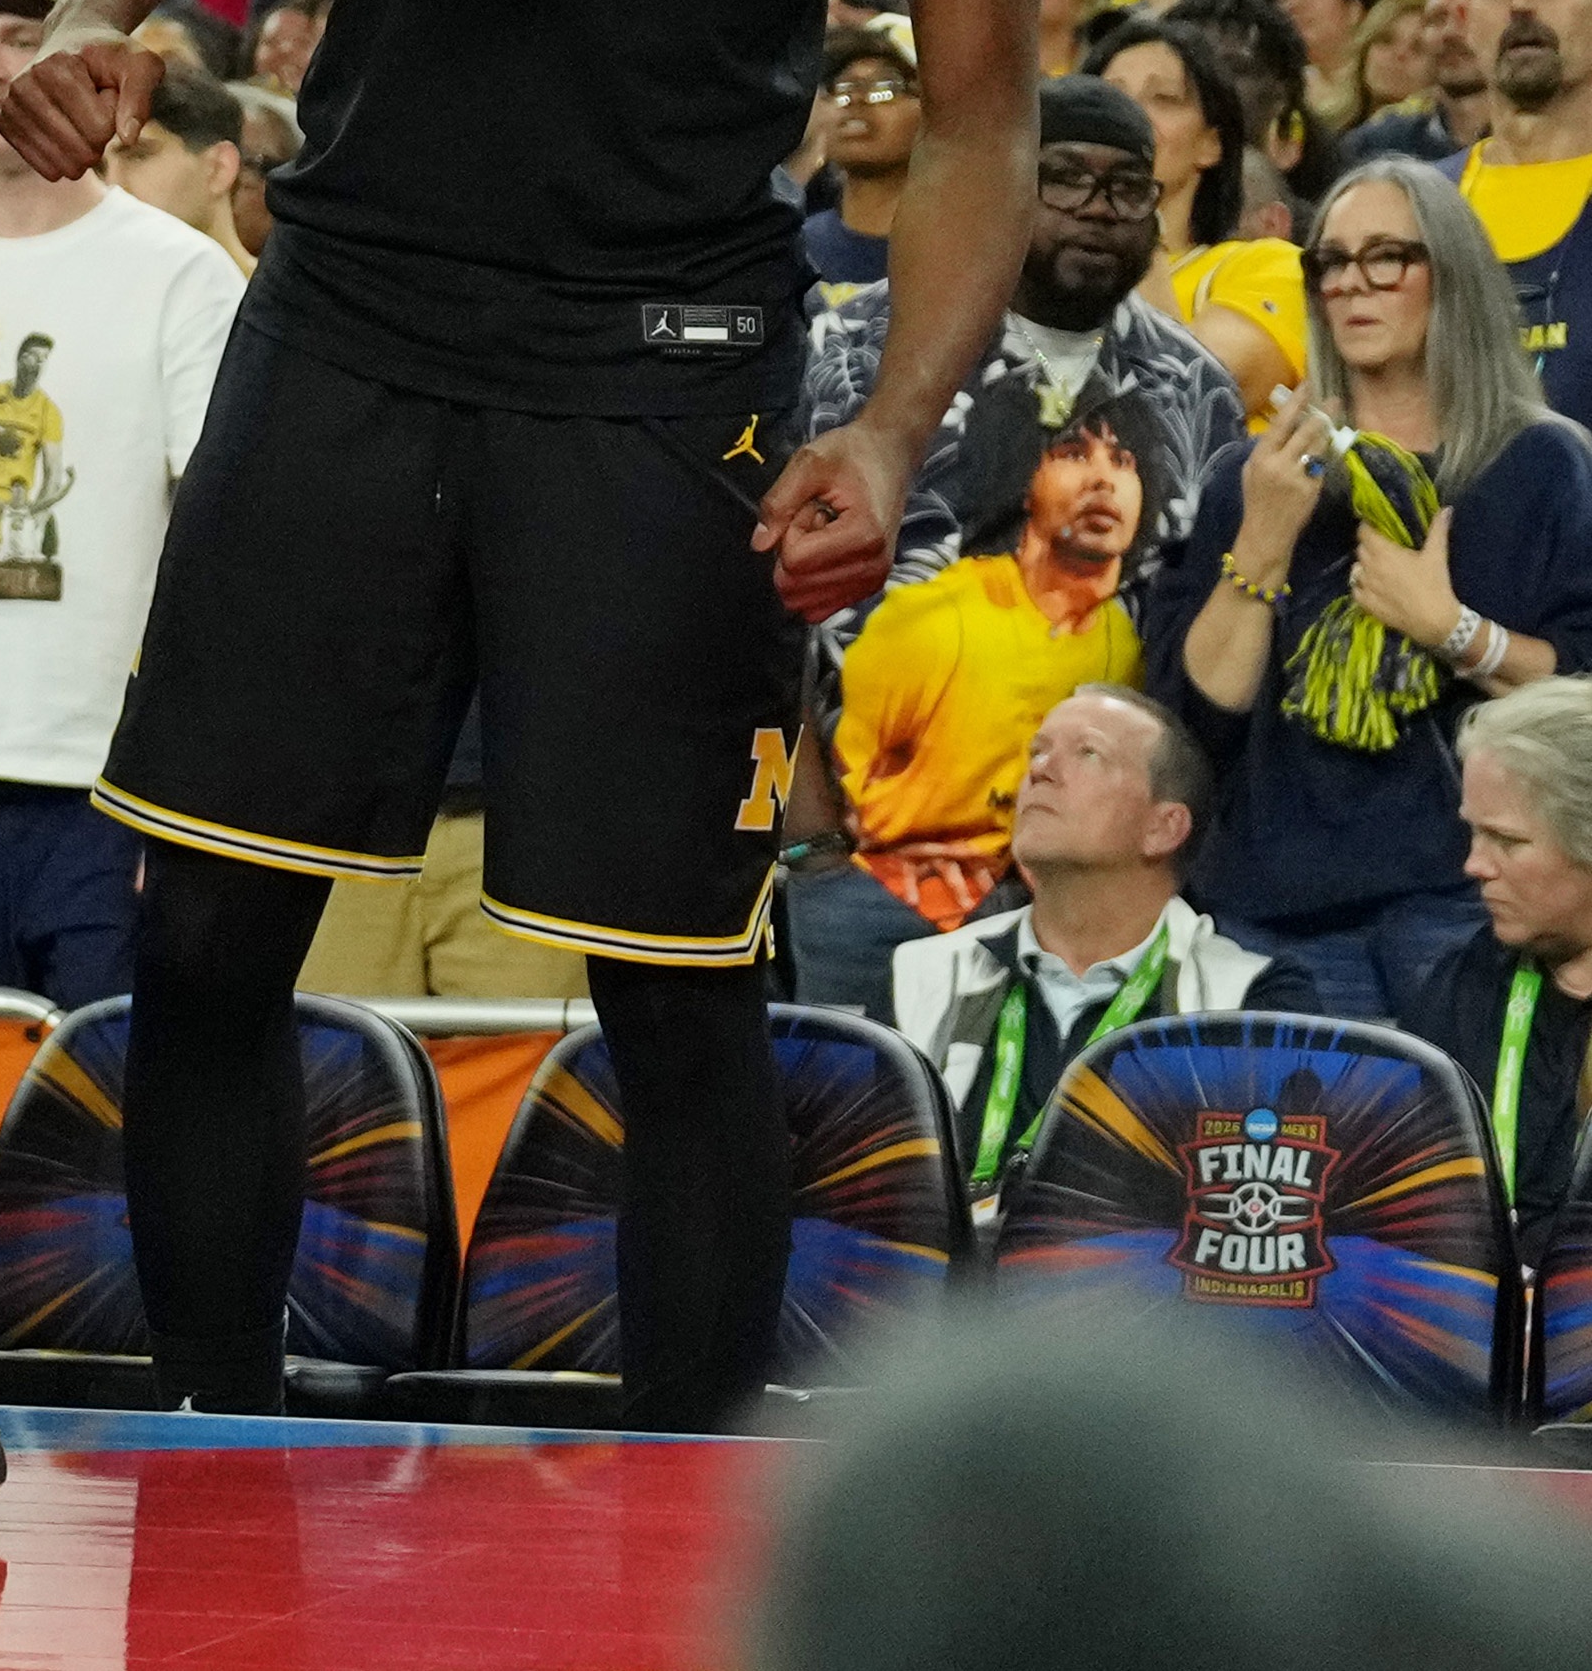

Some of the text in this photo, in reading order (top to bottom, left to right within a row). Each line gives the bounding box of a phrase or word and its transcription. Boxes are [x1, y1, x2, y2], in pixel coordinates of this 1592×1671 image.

[736, 316, 756, 334] 50
[1198, 1143, 1312, 1188] FINAL
[1194, 1227, 1307, 1274] FOUR
[1195, 1276, 1306, 1299] INDIANAPOLIS
